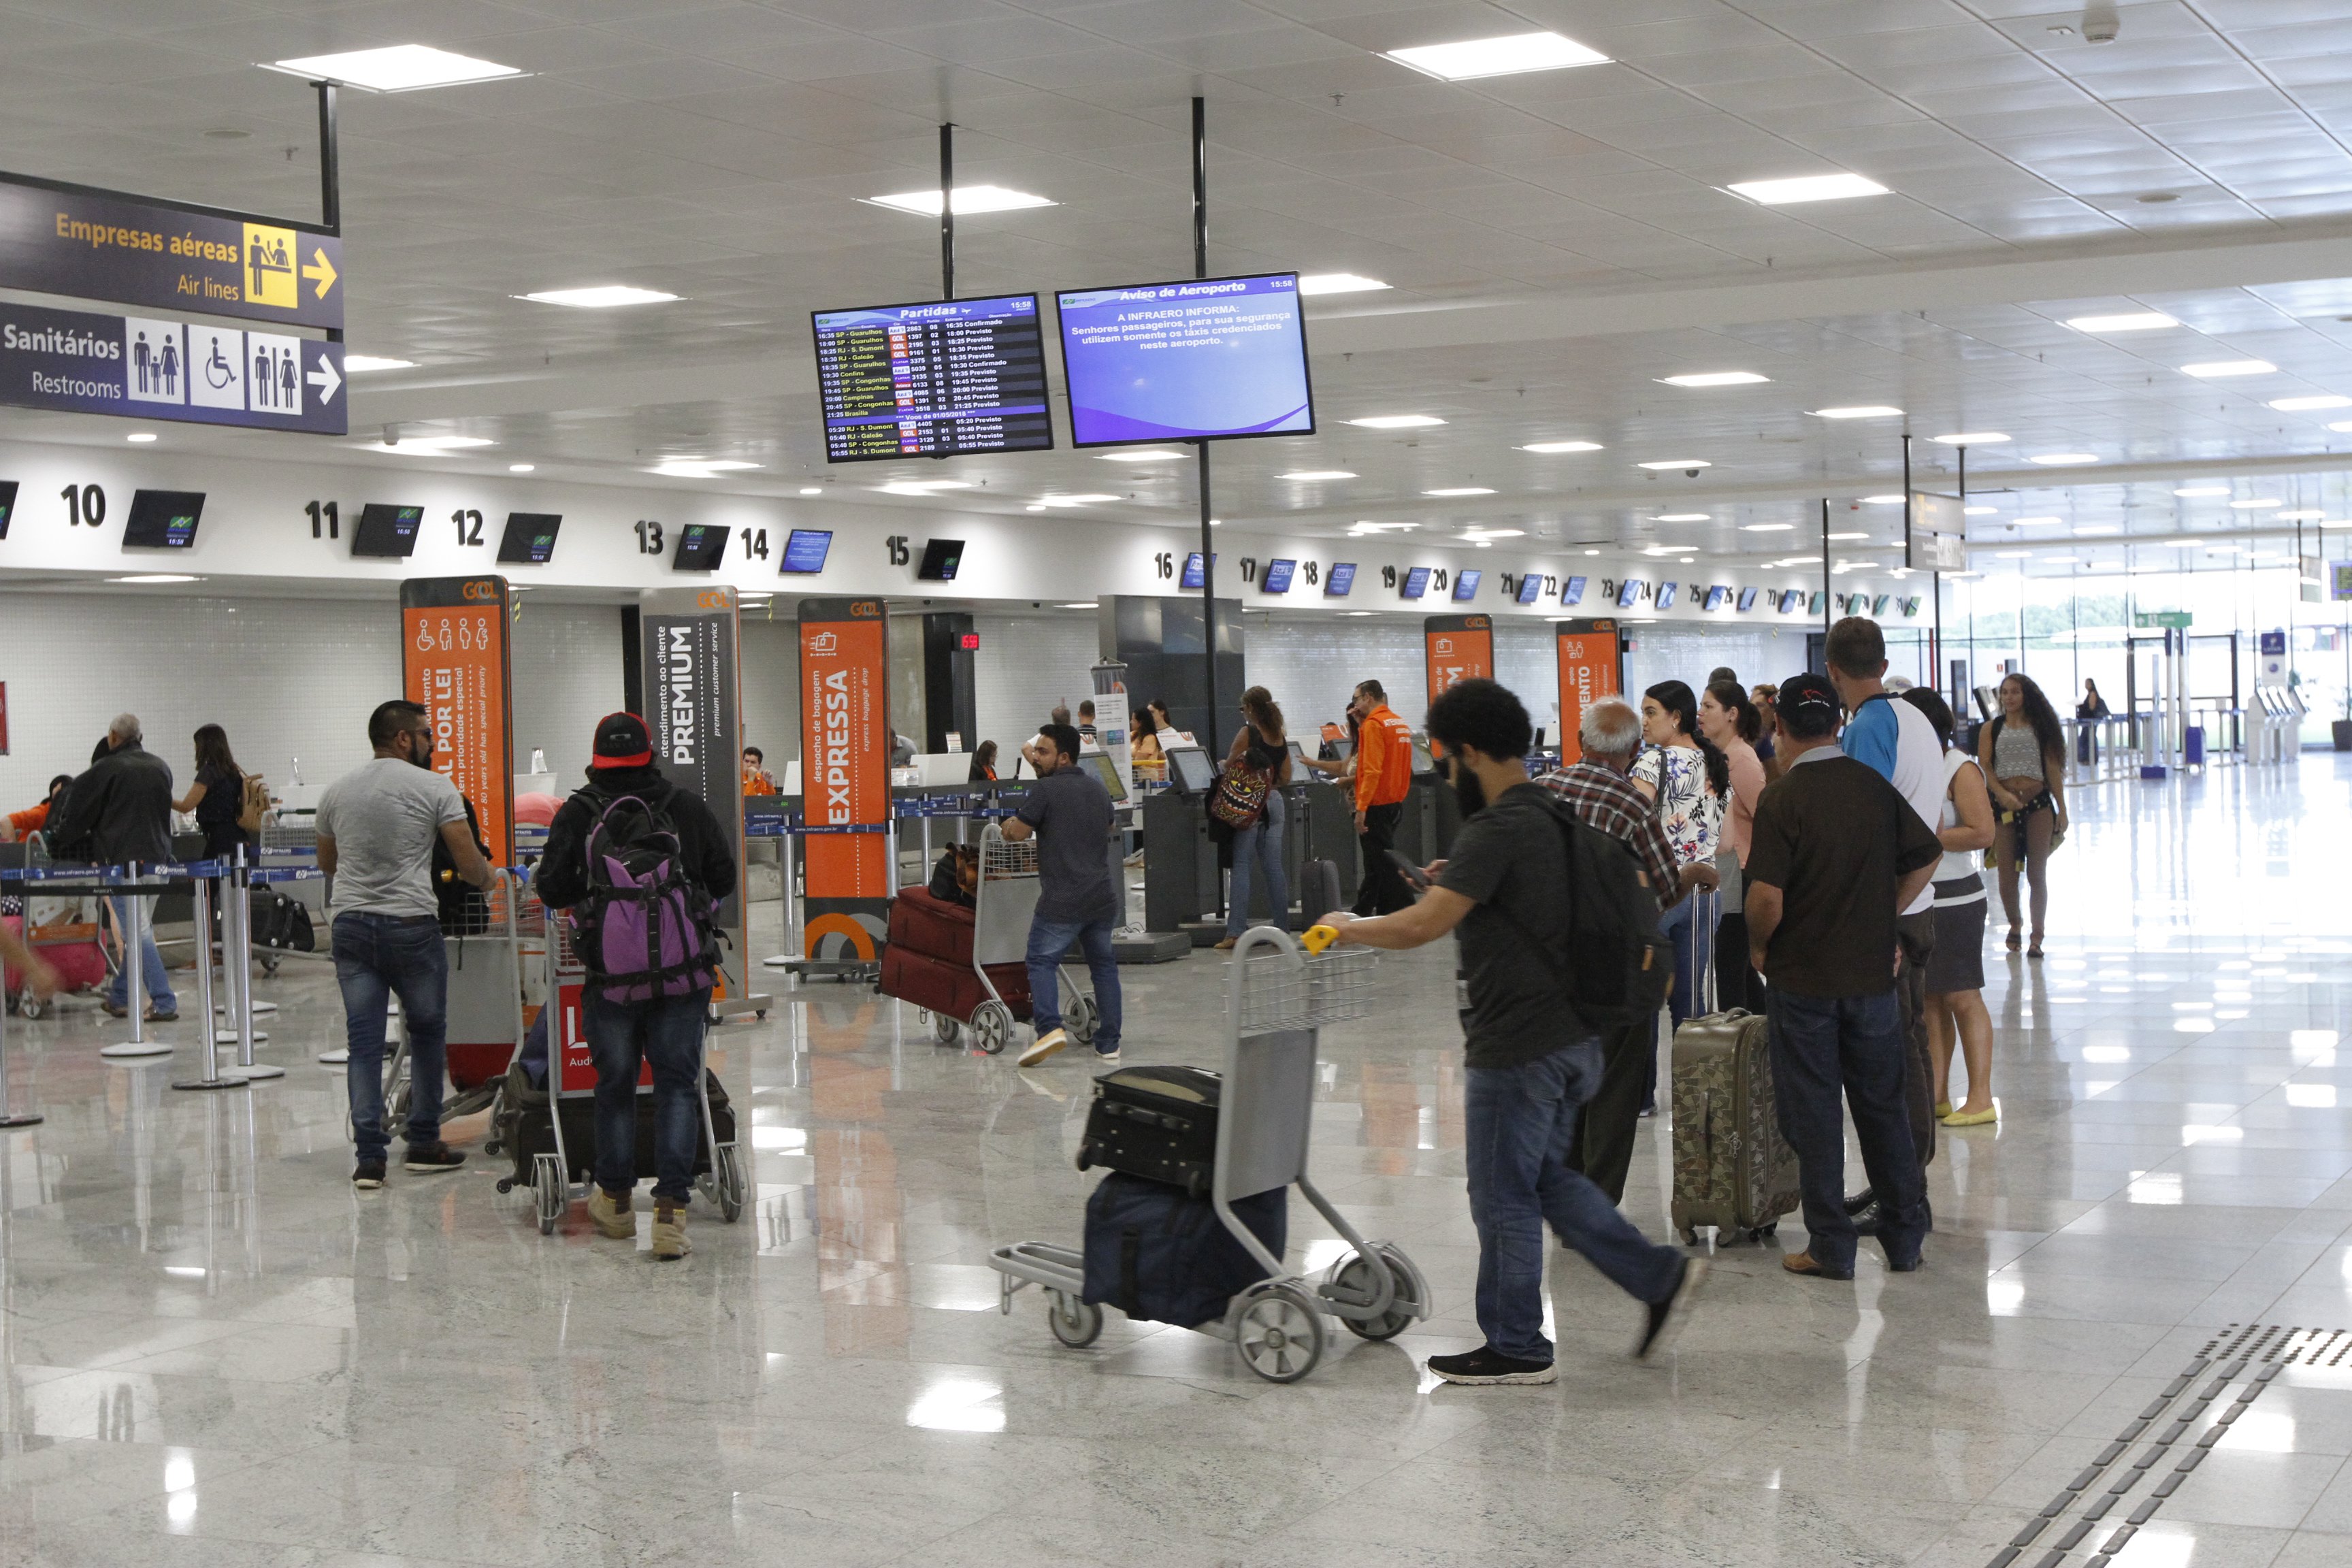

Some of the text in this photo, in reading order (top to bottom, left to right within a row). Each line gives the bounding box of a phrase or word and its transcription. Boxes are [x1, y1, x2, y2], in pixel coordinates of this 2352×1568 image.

[56, 213, 238, 263] Empresas aéreas
[177, 274, 239, 301] Air lines
[1119, 282, 1246, 300] Aviso de Aeroporto
[1270, 280, 1292, 288] 15:58
[899, 305, 957, 318] Partidas
[1071, 324, 1119, 336] Senhores
[1121, 318, 1186, 333] passageiros,
[1188, 318, 1212, 329] para
[1235, 312, 1291, 325] segurança
[1117, 304, 1240, 322] A INFRAERO INFORMA:
[4, 325, 120, 361] Sanitários
[1081, 333, 1121, 344] utilizem
[1122, 331, 1166, 341] somente
[1183, 326, 1209, 336] táxis
[1211, 321, 1282, 334] credenciados
[1139, 337, 1223, 350] neste aeroporto.
[33, 372, 121, 399] Restrooms
[855, 376, 892, 385] Congonhas
[843, 393, 874, 402] Campinas
[858, 400, 894, 409] Congonhas
[932, 410, 966, 419] 01/05/2018
[862, 439, 898, 447] Congonhas
[61, 484, 106, 527] 10
[305, 501, 339, 539] 11
[451, 509, 484, 546] 12
[634, 520, 664, 555] 13
[740, 528, 769, 561] 14
[887, 536, 909, 566] 15
[1155, 553, 1173, 580] 16
[1240, 557, 1256, 583] 17
[1303, 561, 1318, 585] 18
[1382, 565, 1396, 588] 19
[463, 581, 500, 600] GOL
[1433, 568, 1448, 591] 20
[1501, 572, 1514, 594] 21
[1544, 576, 1557, 596] 22
[697, 591, 730, 608] GOL
[851, 602, 881, 617] GOL
[1465, 617, 1489, 628] GOL
[478, 665, 487, 698] priority
[1436, 667, 1442, 675] de
[436, 668, 451, 700] LEI
[455, 667, 465, 710] especial
[657, 626, 668, 758] atendimento ao cliente
[670, 626, 694, 765] PREMIUM
[1578, 666, 1590, 716] MENTO
[478, 700, 488, 730] special
[862, 689, 870, 721] baggage
[437, 706, 453, 752] POR
[813, 670, 823, 783] despacho de bagagem
[455, 713, 467, 769] prioridade
[826, 670, 849, 825] EXPRESSA
[480, 766, 489, 790] years
[480, 791, 488, 804] 80
